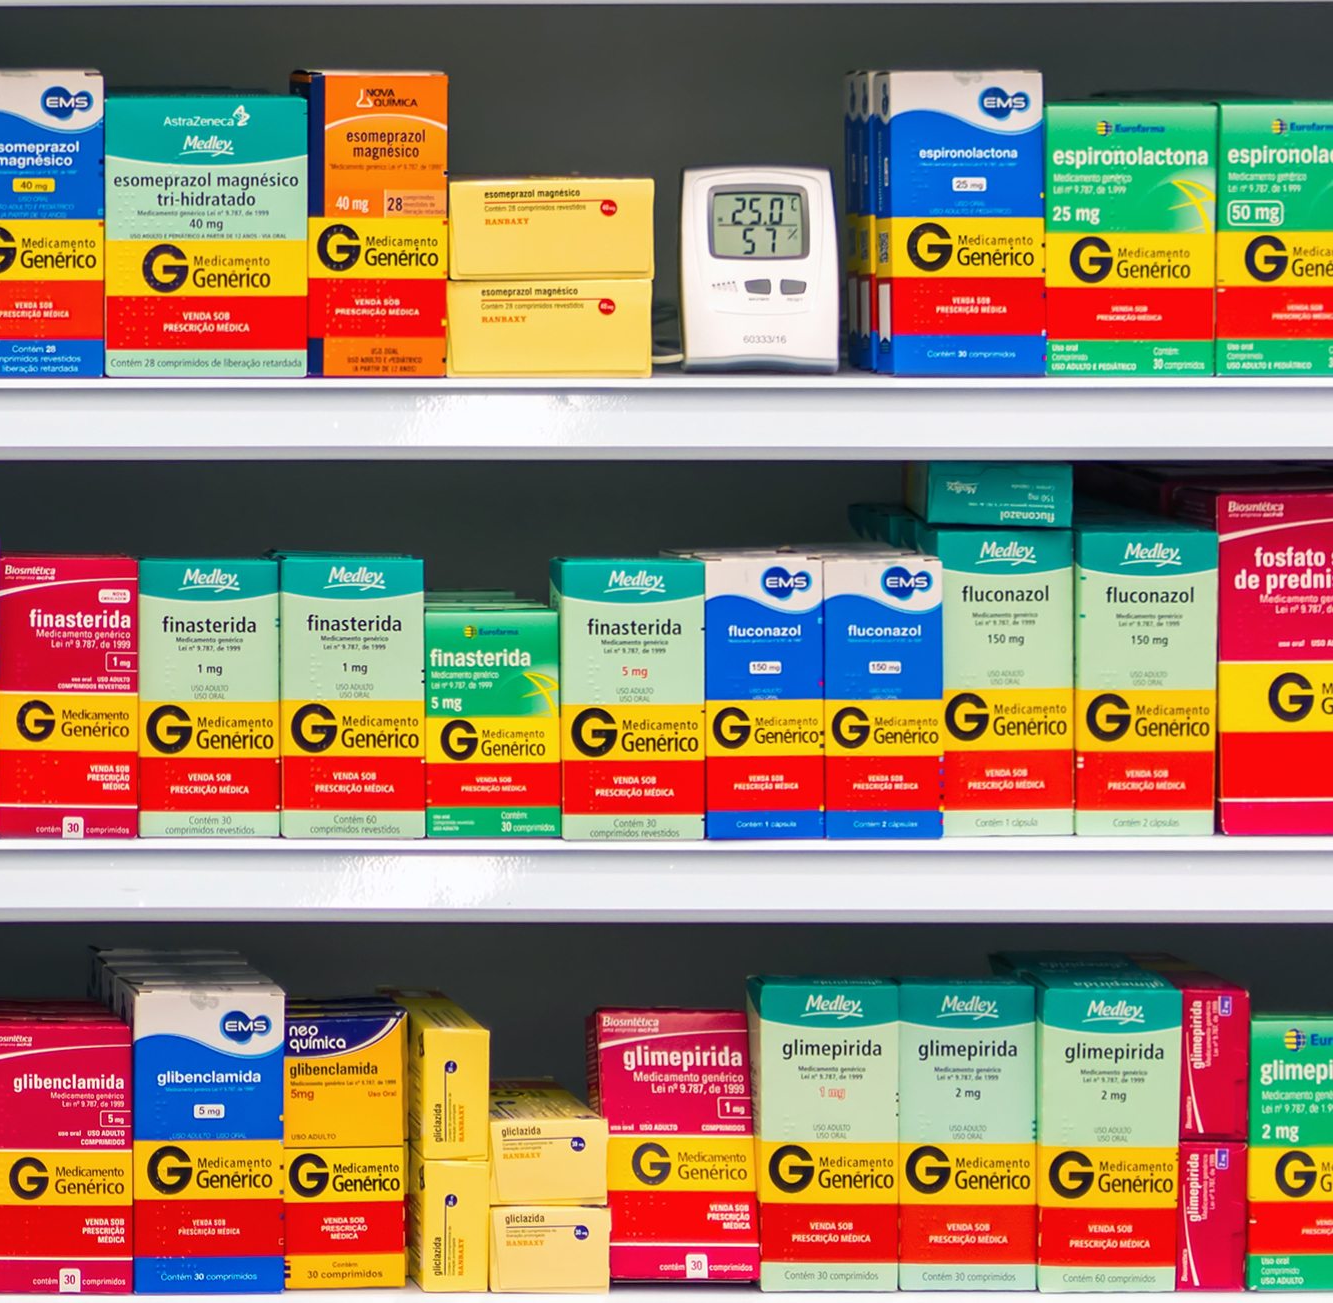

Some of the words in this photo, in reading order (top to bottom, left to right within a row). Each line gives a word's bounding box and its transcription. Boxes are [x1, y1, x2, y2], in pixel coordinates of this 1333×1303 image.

[163, 115, 235, 127] AstraZeneca
[1052, 146, 1209, 170] espironolactona
[113, 172, 211, 191] esomeprazol
[216, 176, 299, 191] magnésico
[157, 191, 256, 207] tri-hidratado
[484, 189, 535, 200] esomeprazol
[537, 189, 581, 199] magnésico
[484, 217, 530, 226] RANBAXY
[1052, 205, 1072, 222] 25
[1075, 208, 1101, 225] mg
[742, 227, 777, 255] 57
[1254, 546, 1326, 568] fosfato
[961, 584, 1049, 603] fluconazol
[162, 615, 257, 633] finasterida
[429, 648, 531, 667] finasterida
[198, 663, 202, 674] 1
[206, 665, 223, 677] mg
[623, 1045, 743, 1072] glimepirida
[782, 1038, 882, 1061] glimepirida
[157, 1069, 262, 1087] glibenclamida
[501, 1126, 542, 1138] gliclazida
[818, 1168, 895, 1189] Genérico
